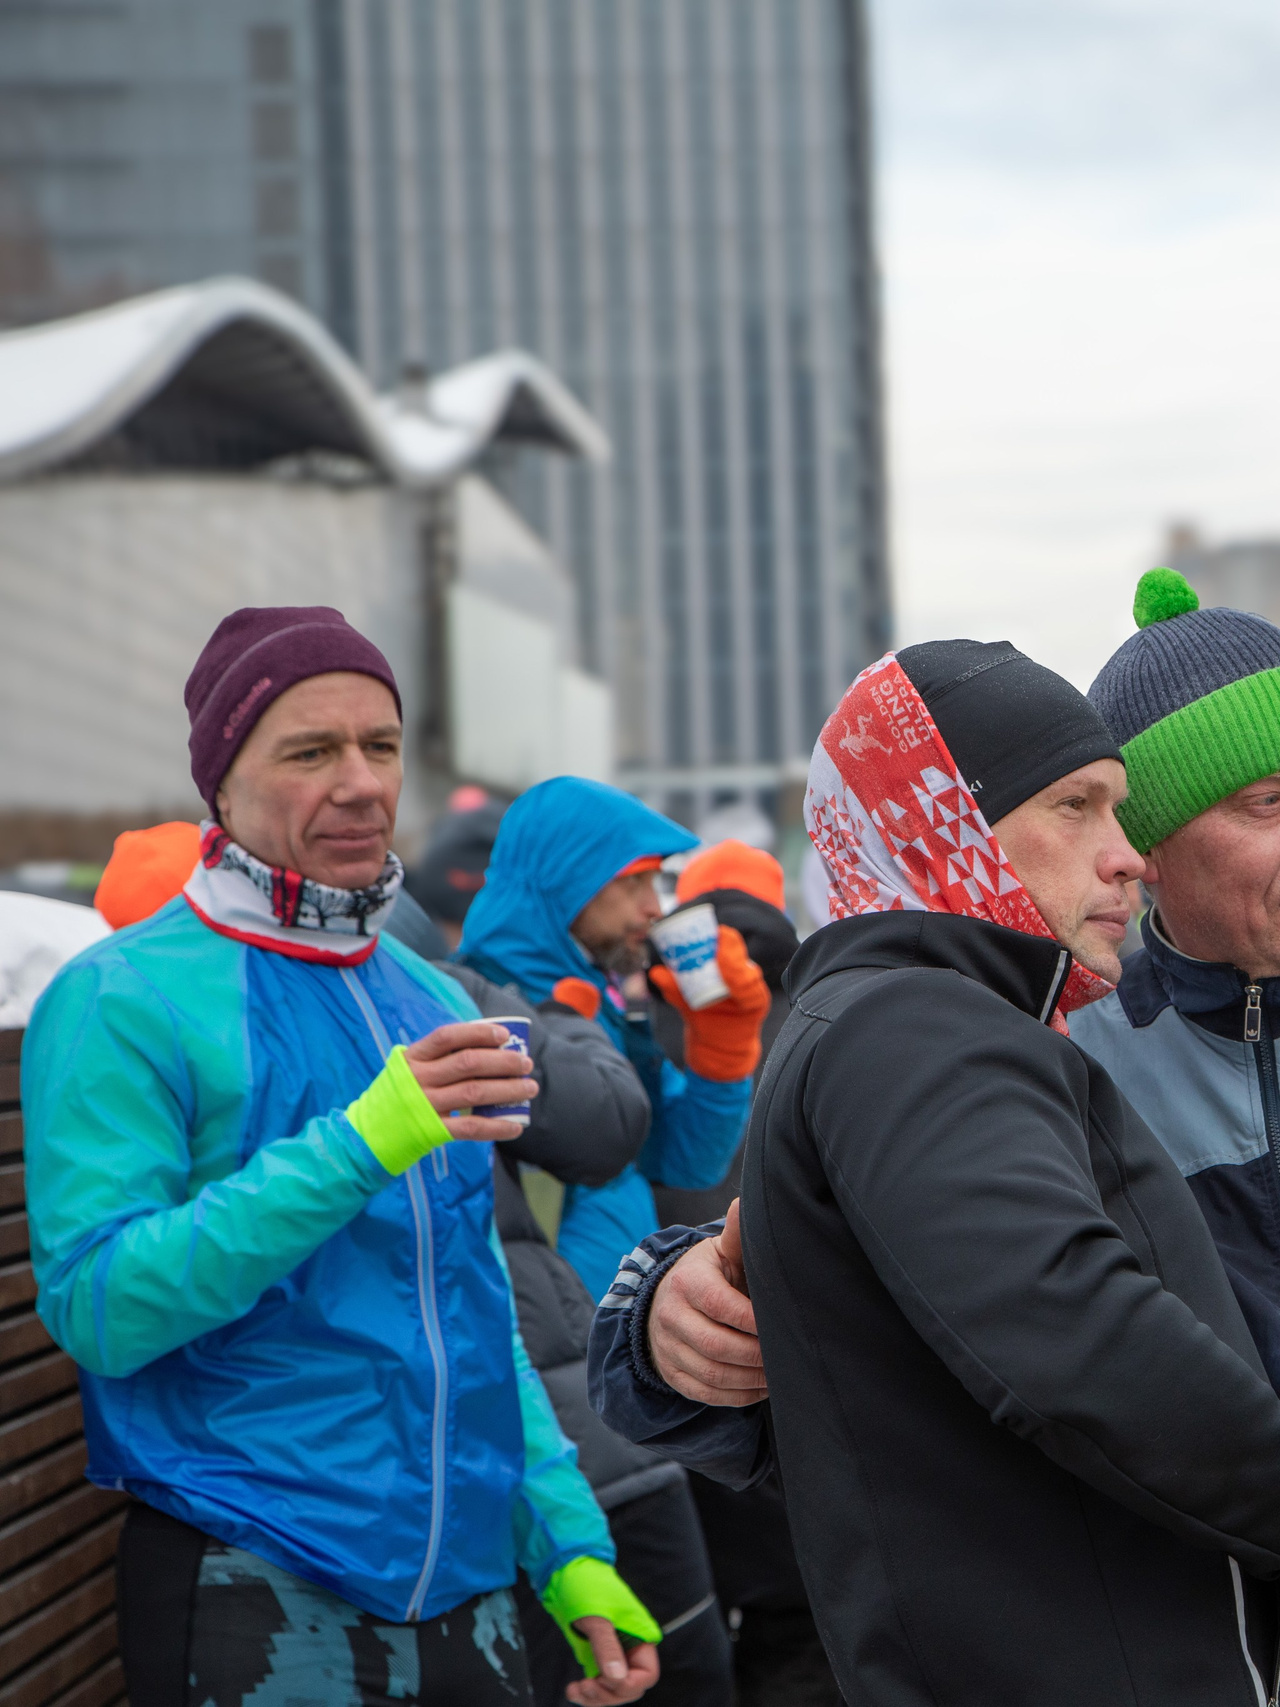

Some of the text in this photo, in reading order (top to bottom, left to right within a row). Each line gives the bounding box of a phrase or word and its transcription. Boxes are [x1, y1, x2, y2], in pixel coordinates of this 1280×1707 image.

[869, 685, 908, 754] GOLDEN
[880, 678, 921, 750] RING
[893, 671, 931, 742] ULTRA
